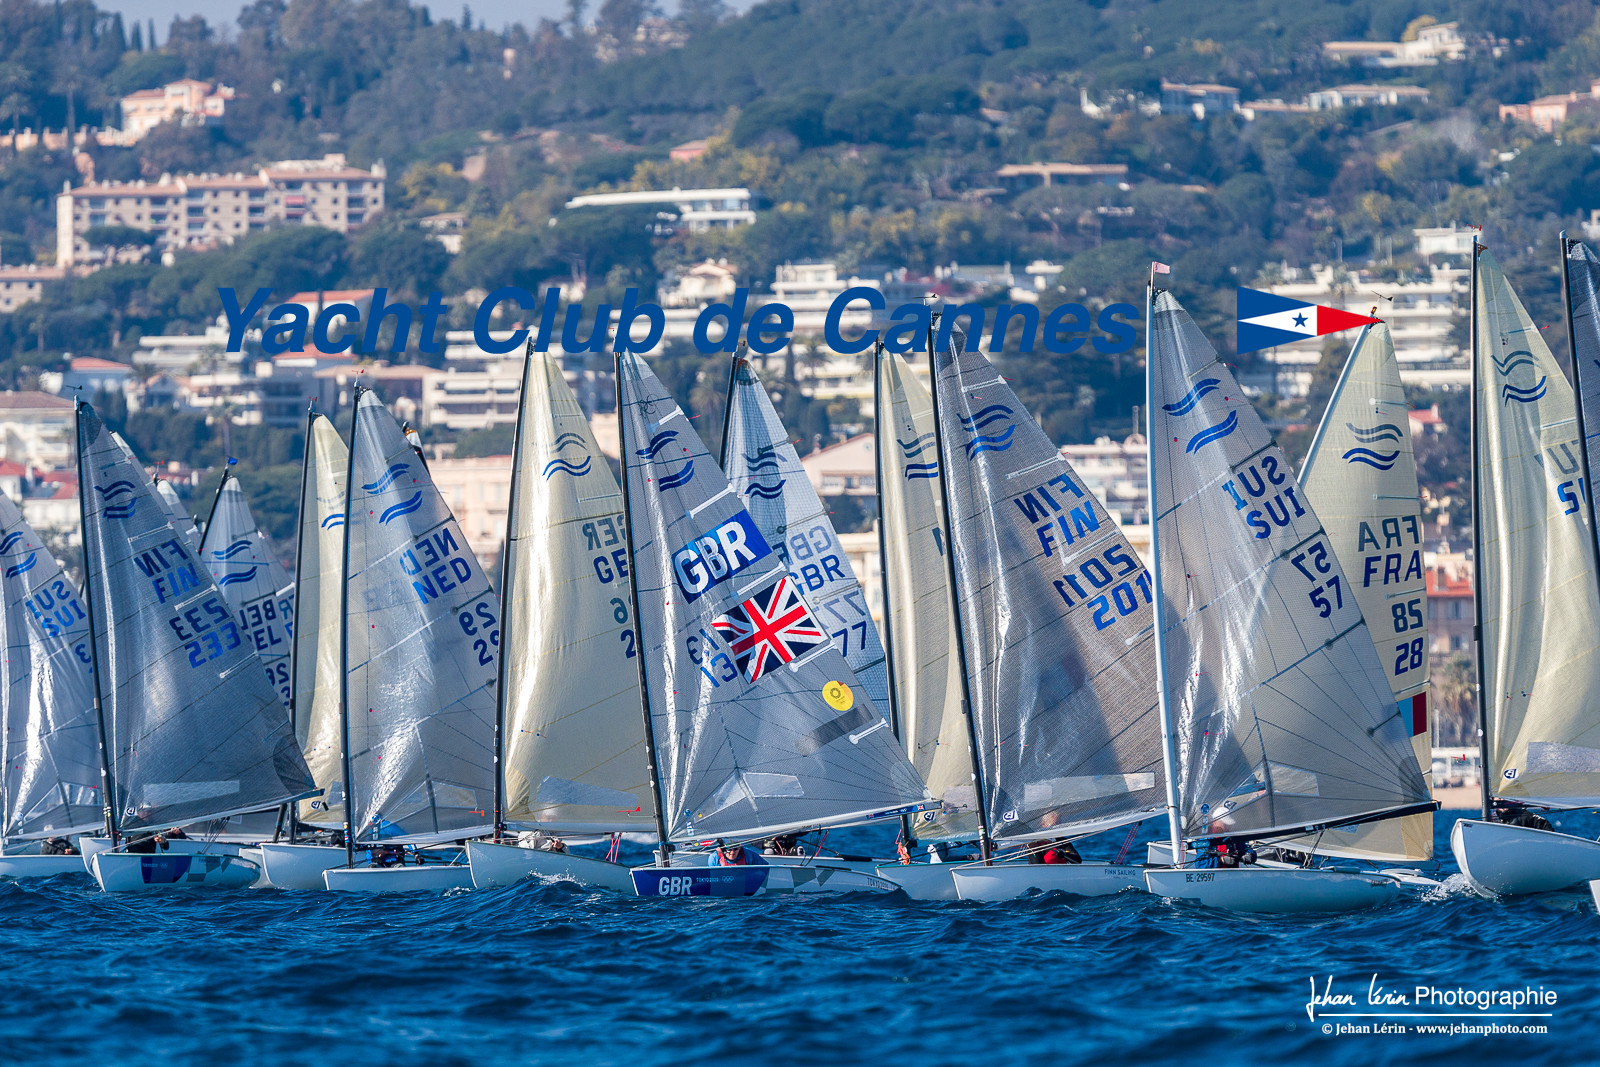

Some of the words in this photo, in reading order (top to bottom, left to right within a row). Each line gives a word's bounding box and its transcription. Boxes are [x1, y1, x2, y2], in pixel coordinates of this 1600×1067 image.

[1036, 500, 1100, 558] FIN
[1246, 486, 1306, 539] SUI
[593, 548, 629, 584] GE
[674, 521, 756, 594] GBR
[1363, 550, 1422, 587] FRA
[152, 563, 200, 604] FIN
[412, 557, 472, 604] NED
[1087, 569, 1153, 631] 201
[1309, 575, 1343, 618] 57
[41, 599, 87, 637] SUI
[247, 625, 282, 650] EL
[185, 622, 241, 668] 233
[1395, 637, 1423, 676] 28
[700, 652, 738, 688] 13
[658, 876, 693, 895] GBR
[1185, 873, 1194, 882] BE
[1196, 873, 1215, 882] 29597
